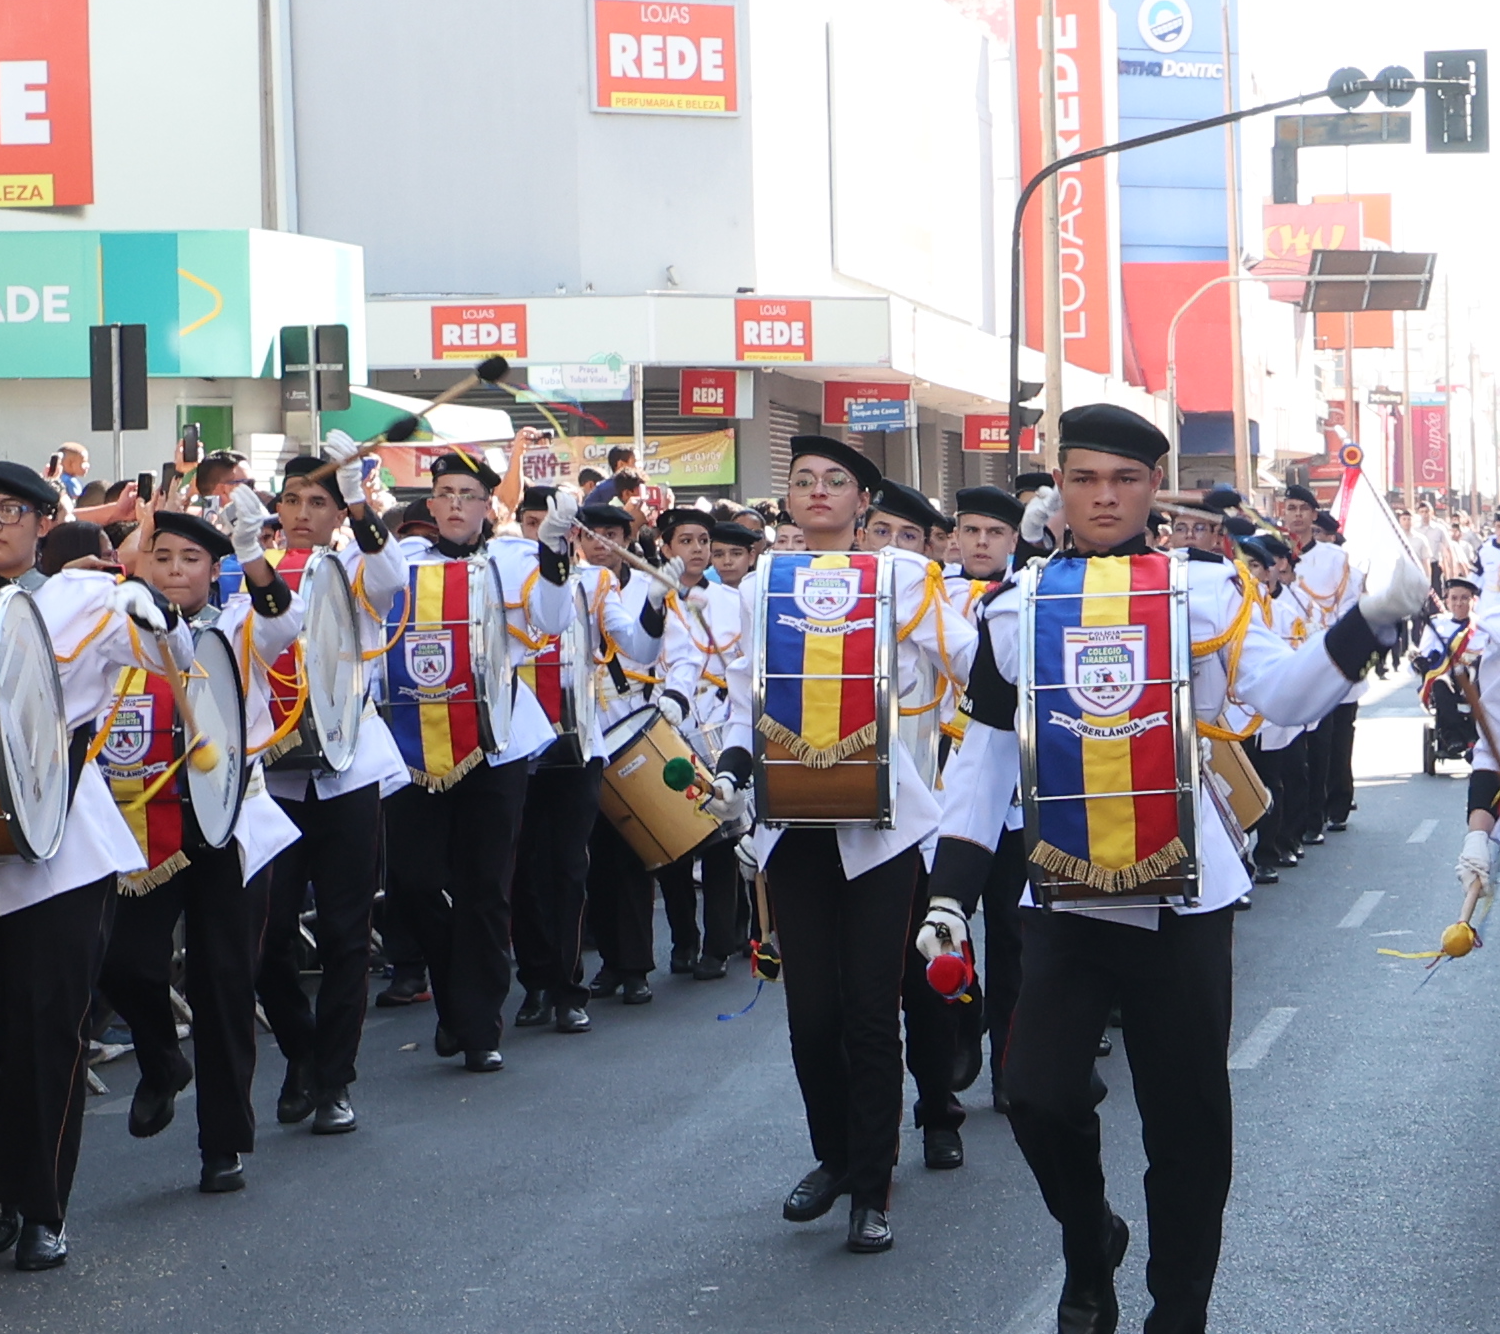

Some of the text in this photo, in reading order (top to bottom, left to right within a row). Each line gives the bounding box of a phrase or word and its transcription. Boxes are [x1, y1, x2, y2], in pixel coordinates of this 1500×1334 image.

[640, 4, 690, 24] LOJAS
[608, 32, 725, 82] REDE
[615, 96, 721, 110] PERFUMARIA E BELEZA
[462, 309, 495, 320] LOJAS
[759, 304, 786, 316] LOJAS
[441, 322, 518, 346] REDE
[742, 320, 804, 346] REDE
[578, 365, 598, 374] Praça
[539, 377, 561, 385] Tuba
[692, 387, 724, 404] REDE
[1087, 646, 1122, 656] COLÉGIO
[1081, 654, 1128, 664] TIRADENTES
[1076, 721, 1140, 737] UBERLÂNDIA
